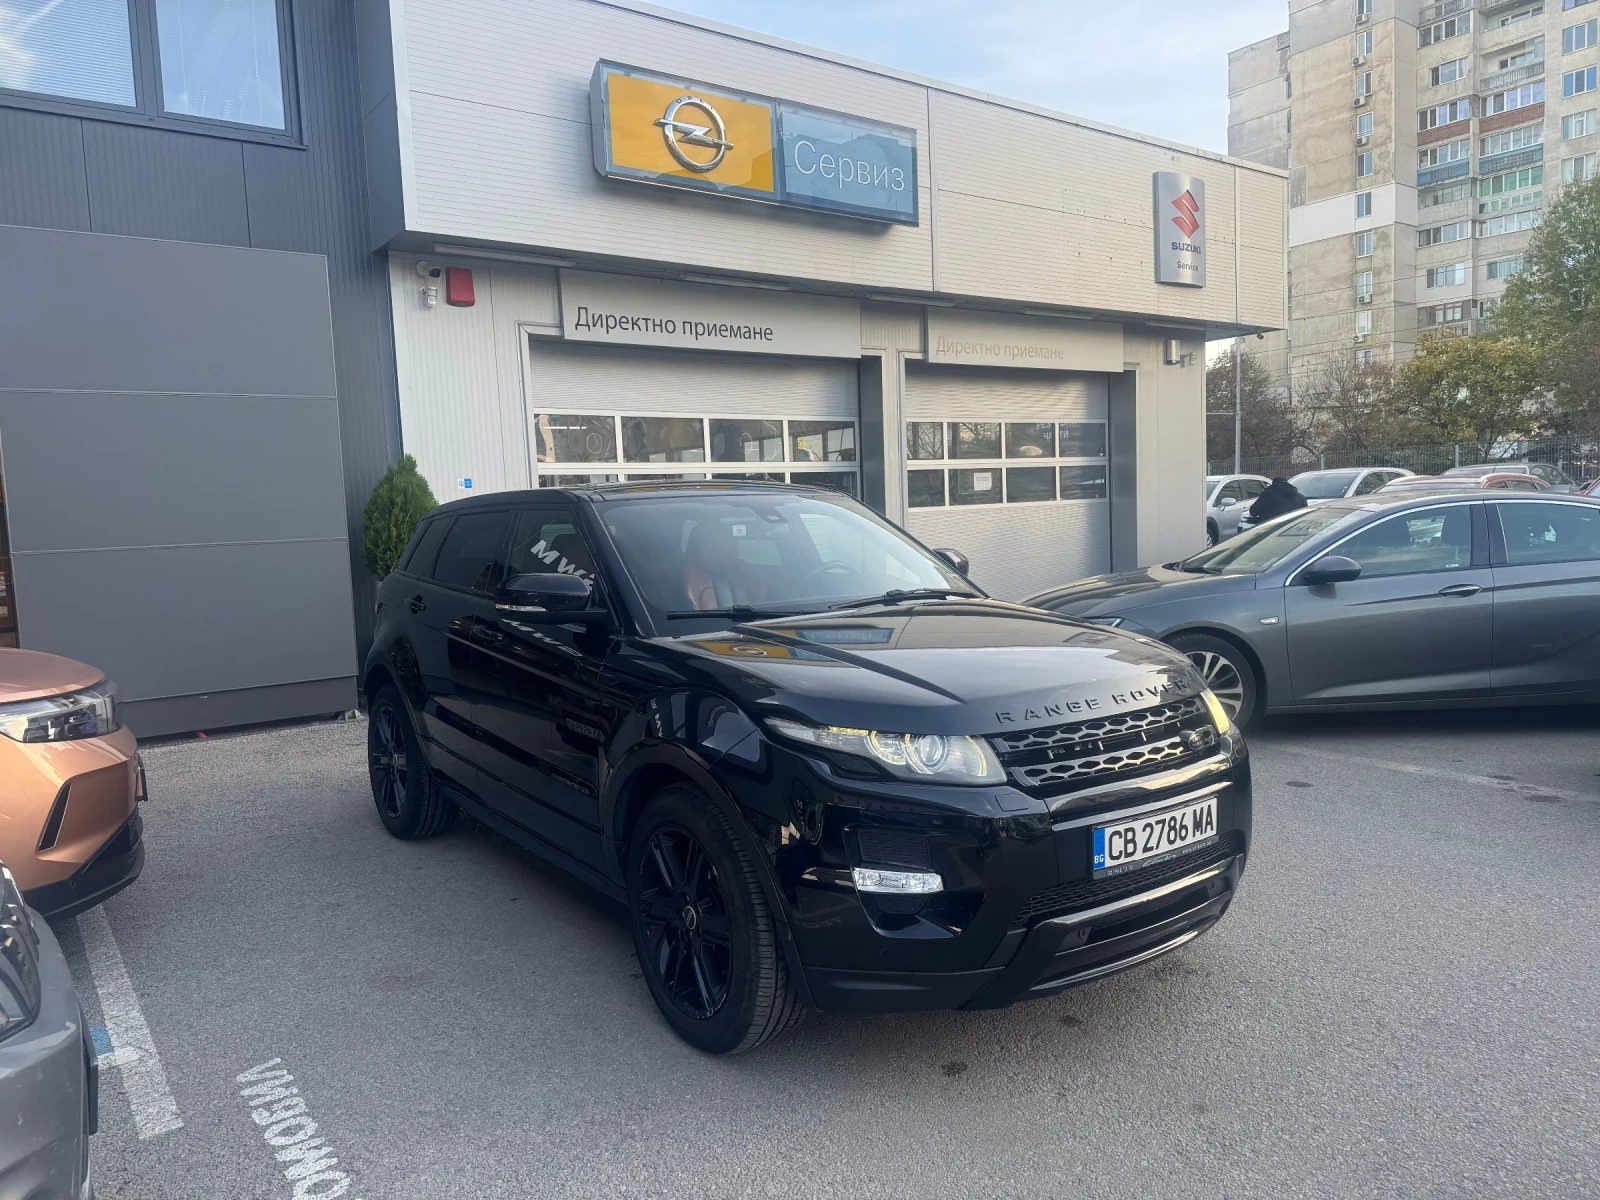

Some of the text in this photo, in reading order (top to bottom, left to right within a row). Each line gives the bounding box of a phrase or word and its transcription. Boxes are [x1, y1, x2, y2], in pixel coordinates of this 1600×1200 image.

[793, 140, 905, 192] Сервиз
[1171, 242, 1202, 255] SUZUKI
[1177, 260, 1199, 272] Service
[575, 306, 773, 341] Директно приемане
[936, 336, 1064, 361] Директно приемане
[995, 678, 1190, 724] RANGE ROVER
[1108, 827, 1138, 861] CB
[1142, 812, 1189, 853] 2786
[1192, 804, 1214, 838] MA
[1094, 854, 1104, 864] BG
